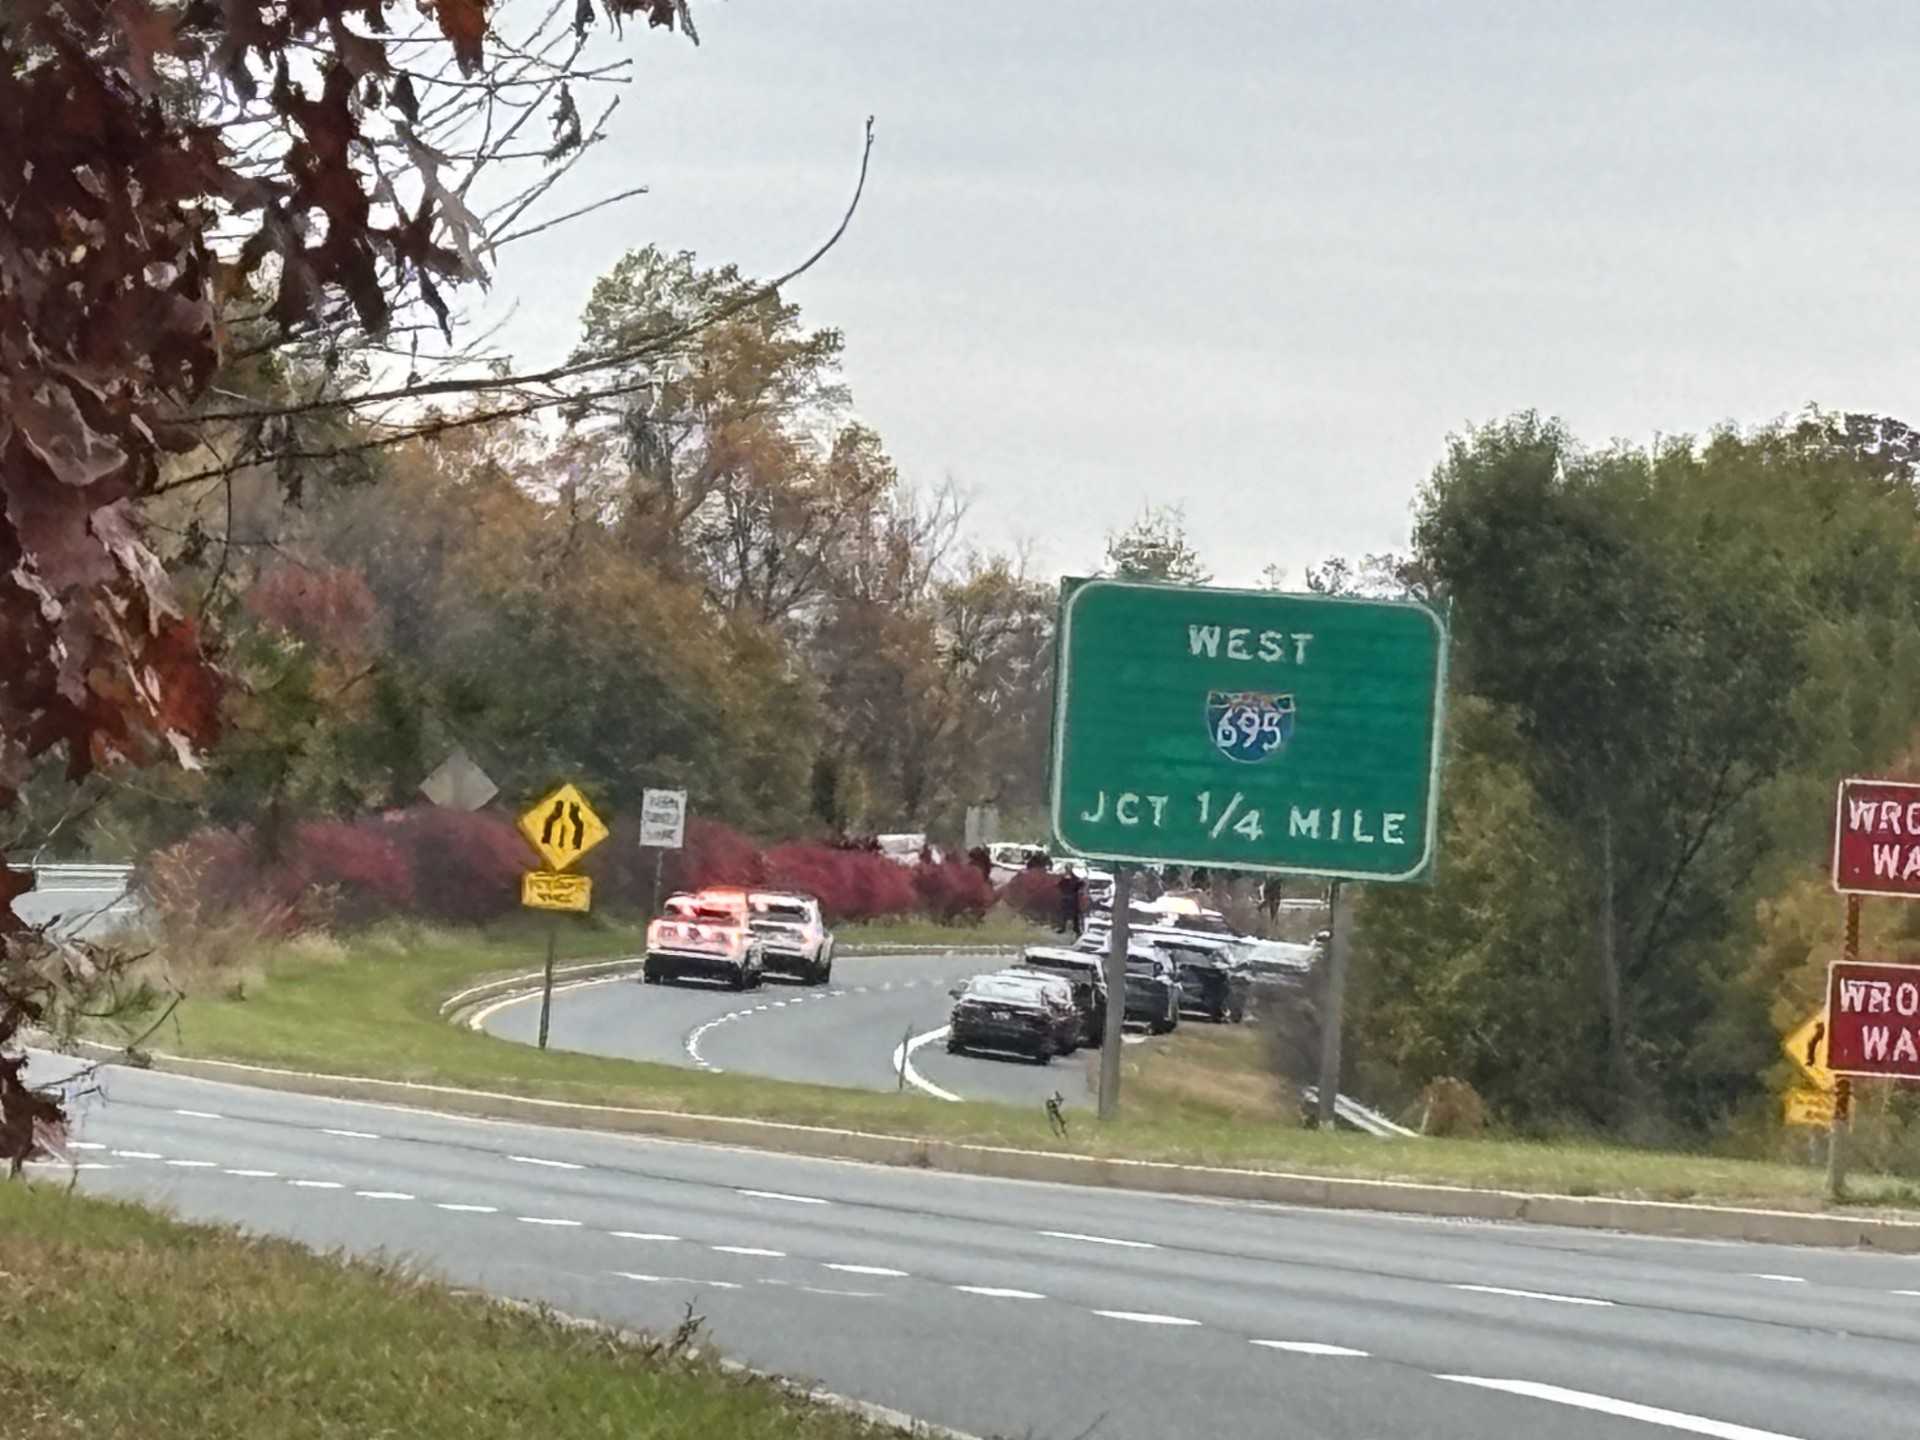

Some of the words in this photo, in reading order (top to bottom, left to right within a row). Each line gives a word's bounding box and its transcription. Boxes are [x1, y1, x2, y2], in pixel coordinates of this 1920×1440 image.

[1189, 625, 1314, 664] WEST
[1217, 708, 1281, 750] 695
[1082, 792, 1168, 826] JCT
[1197, 793, 1263, 841] 1/4
[1289, 806, 1406, 844] MILE
